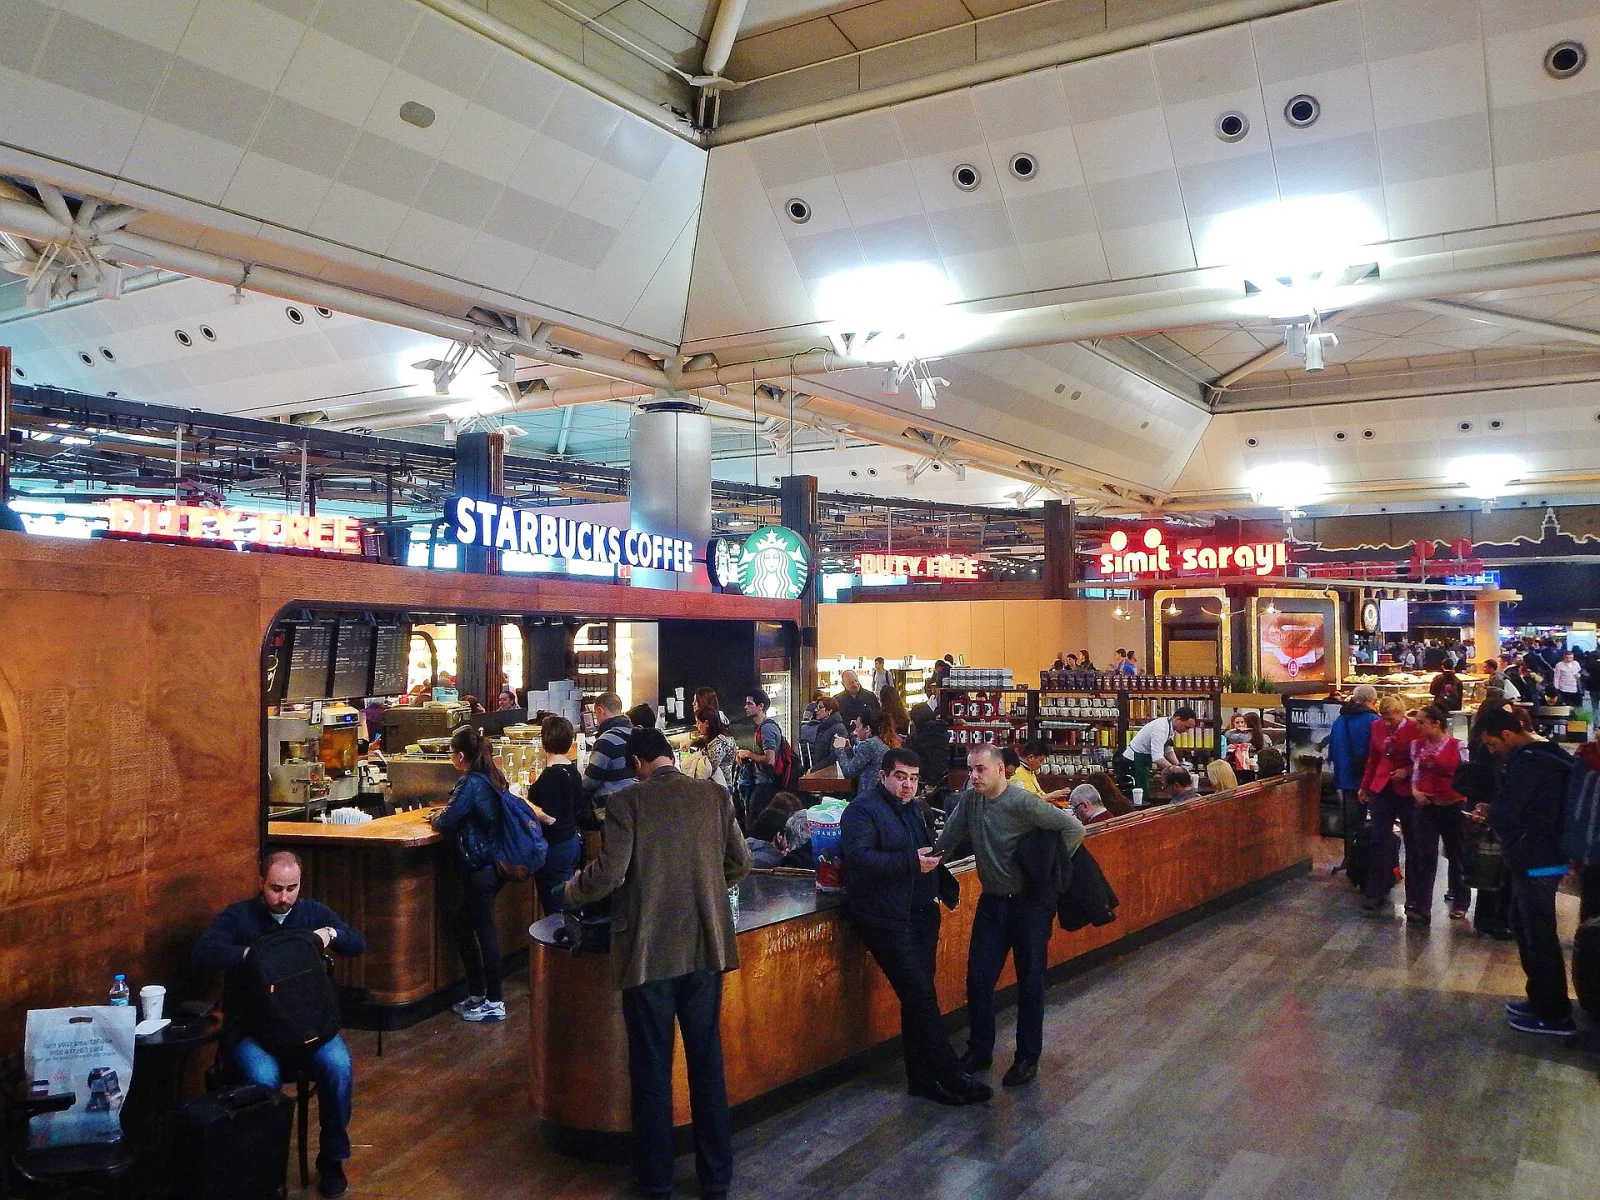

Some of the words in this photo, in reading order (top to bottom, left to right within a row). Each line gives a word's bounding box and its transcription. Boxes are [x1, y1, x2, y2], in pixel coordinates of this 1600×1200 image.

[108, 499, 247, 541] DUTY
[258, 513, 362, 551] FREE
[456, 497, 620, 564] STARBUCKS
[625, 528, 693, 573] COFFEE
[860, 554, 921, 577] DUTY
[926, 555, 979, 579] FREE
[1100, 528, 1171, 574] simit
